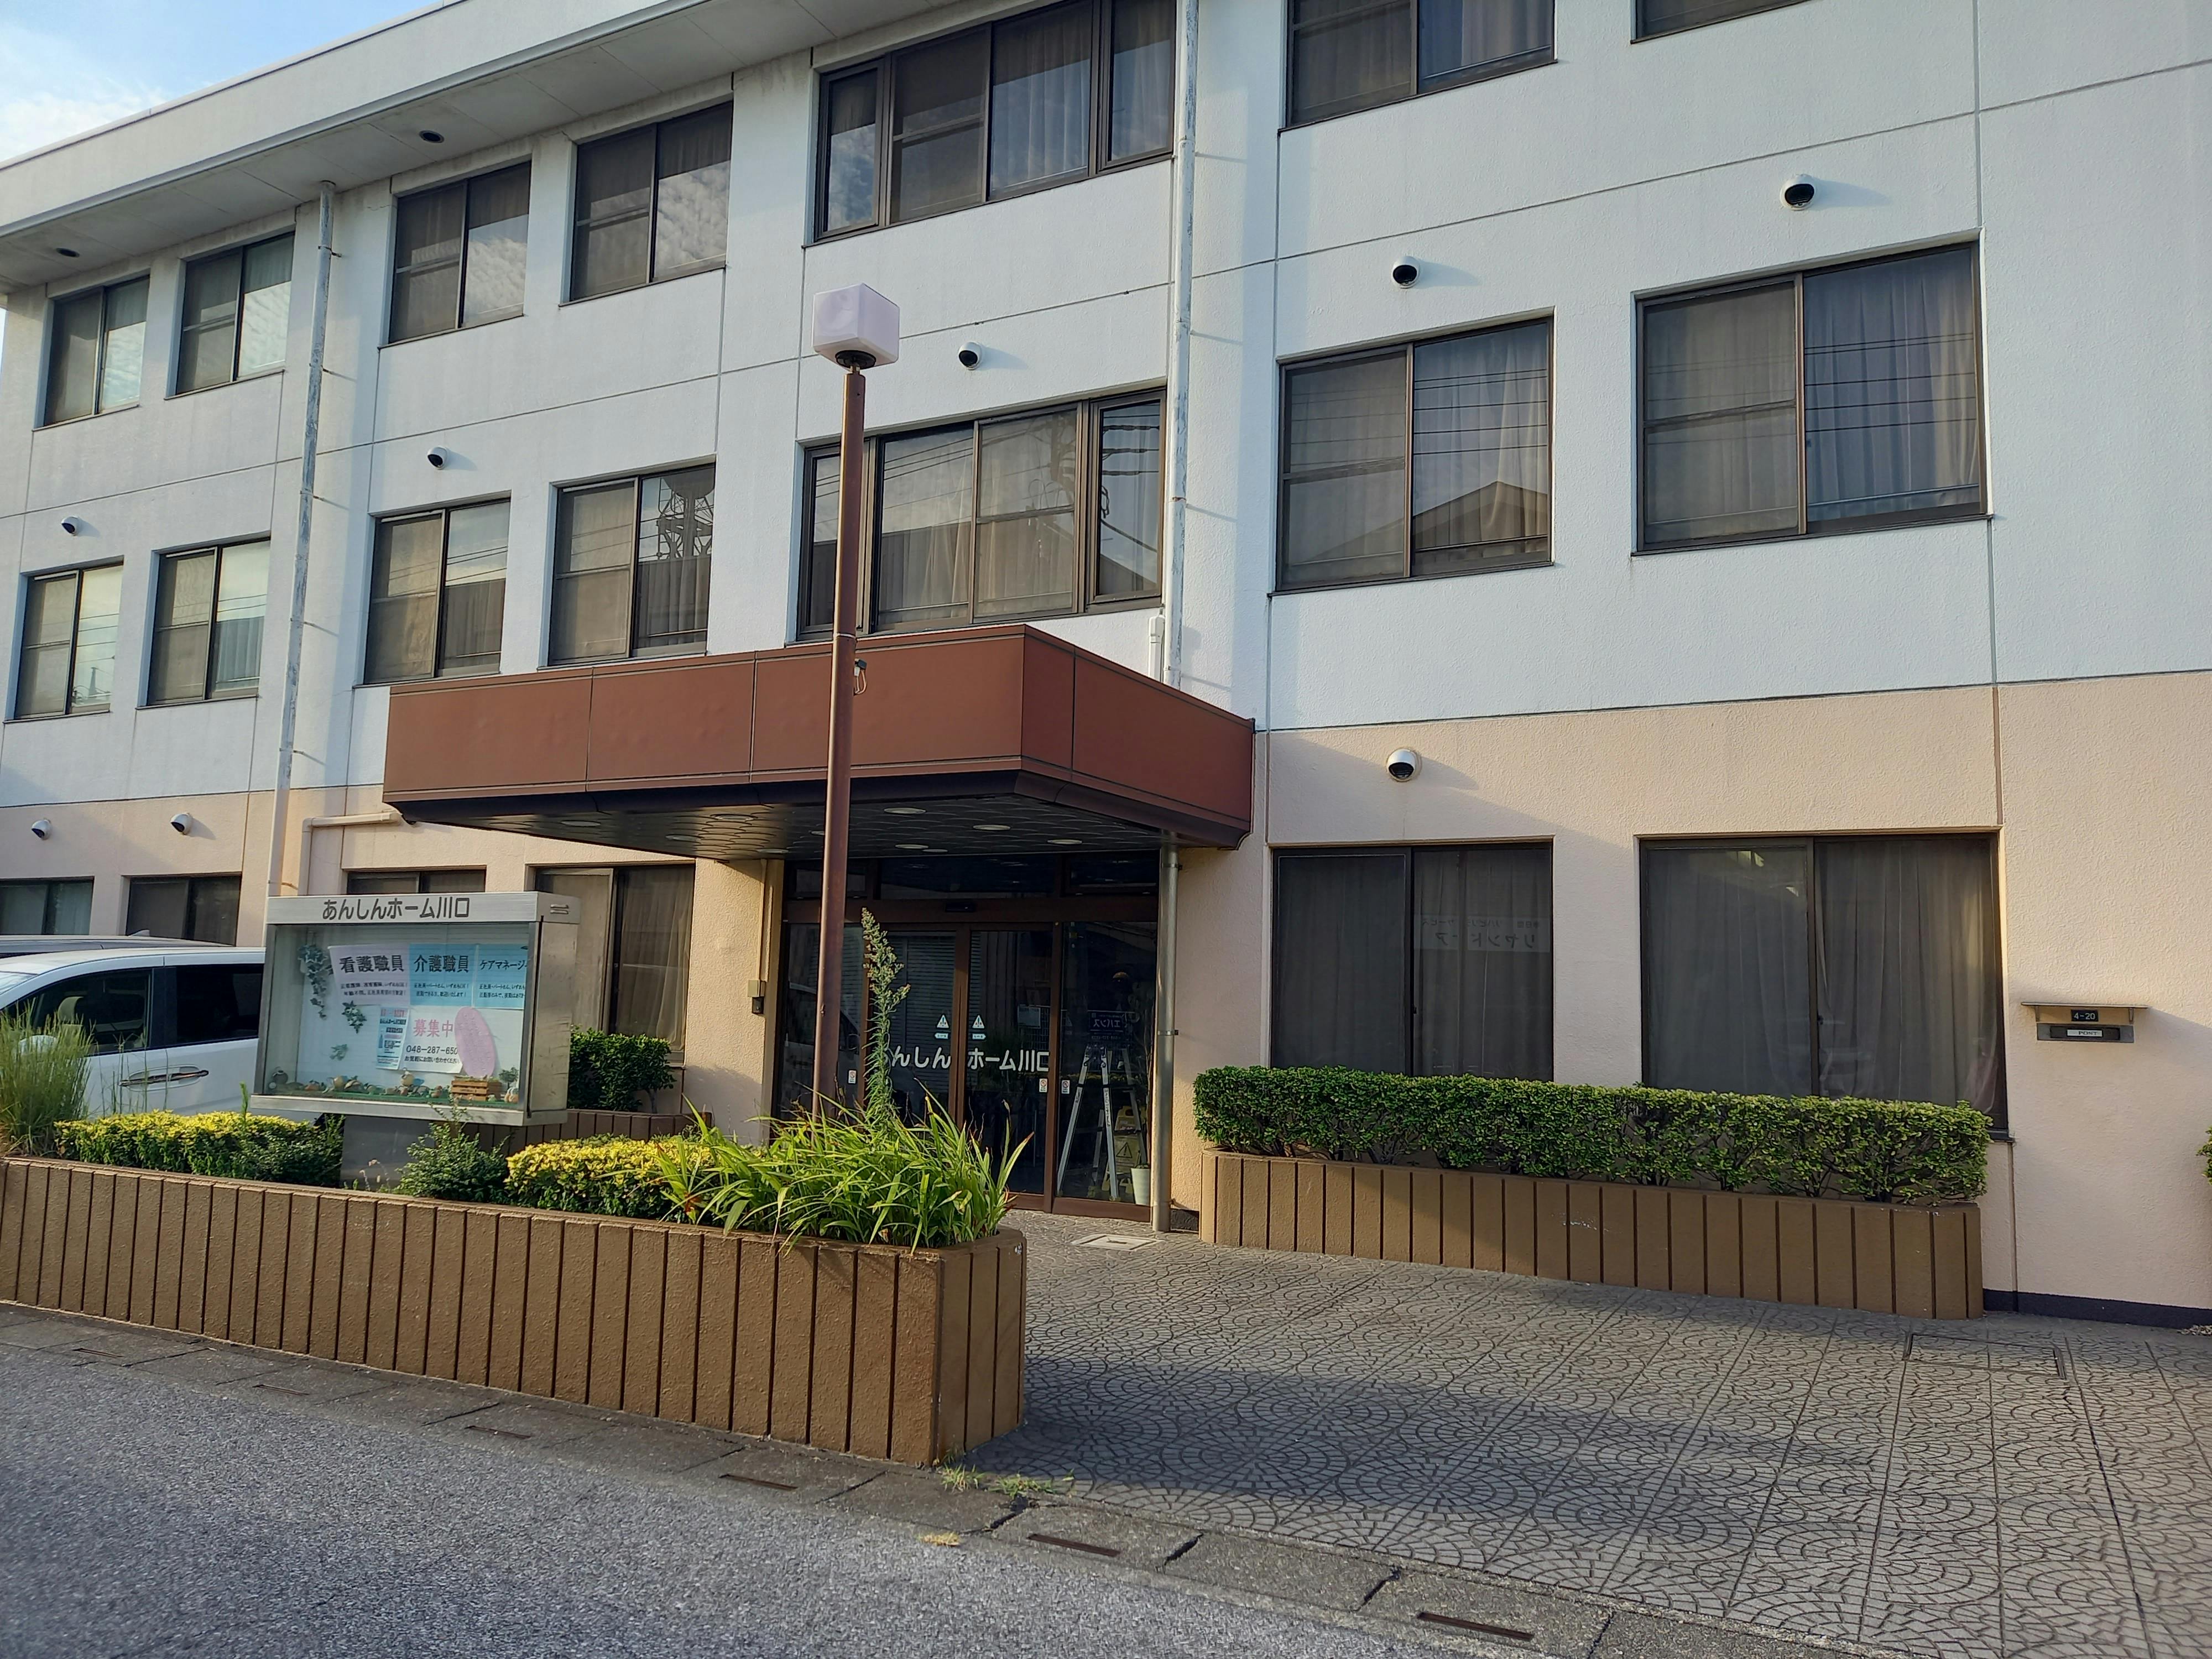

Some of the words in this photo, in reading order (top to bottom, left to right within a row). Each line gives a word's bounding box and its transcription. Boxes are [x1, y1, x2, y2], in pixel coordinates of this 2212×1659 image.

[322, 896, 469, 920] あんしんホーム川口
[340, 954, 404, 973] 看護職員
[414, 954, 469, 973] 介護職員
[480, 960, 528, 971] ケアマネージ
[413, 1018, 453, 1037] 募集中
[884, 1045, 951, 1069] んしん
[968, 1048, 1049, 1072] ホーム川口
